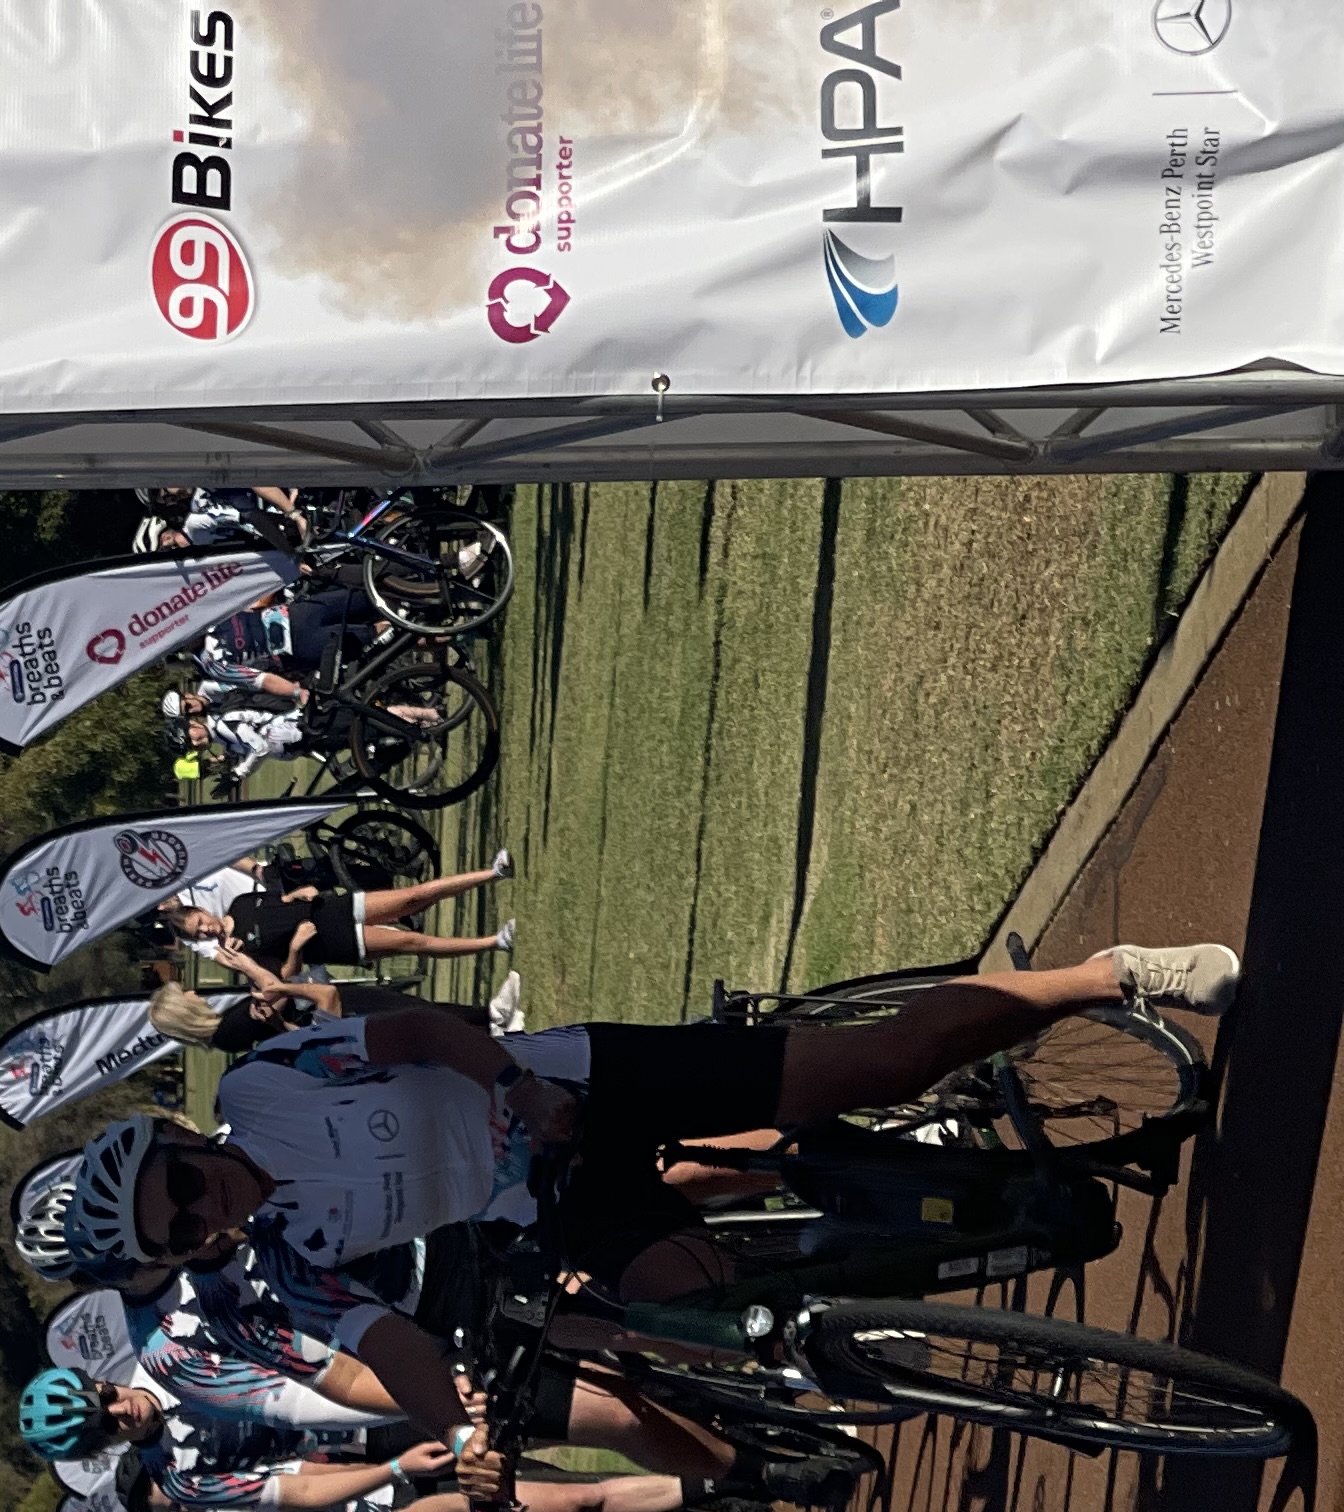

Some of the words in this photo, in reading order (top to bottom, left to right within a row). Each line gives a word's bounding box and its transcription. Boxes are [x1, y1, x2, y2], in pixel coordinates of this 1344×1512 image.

[820, 0, 905, 223] HPA
[1161, 128, 1189, 179] Perth
[1195, 126, 1221, 167] Star
[554, 135, 576, 252] supporter
[1191, 172, 1219, 268] Westpoint
[169, 225, 230, 339] 99
[1159, 186, 1183, 335] Mercedes-Benz
[11, 622, 47, 705] breaths
[43, 867, 73, 933] breaths
